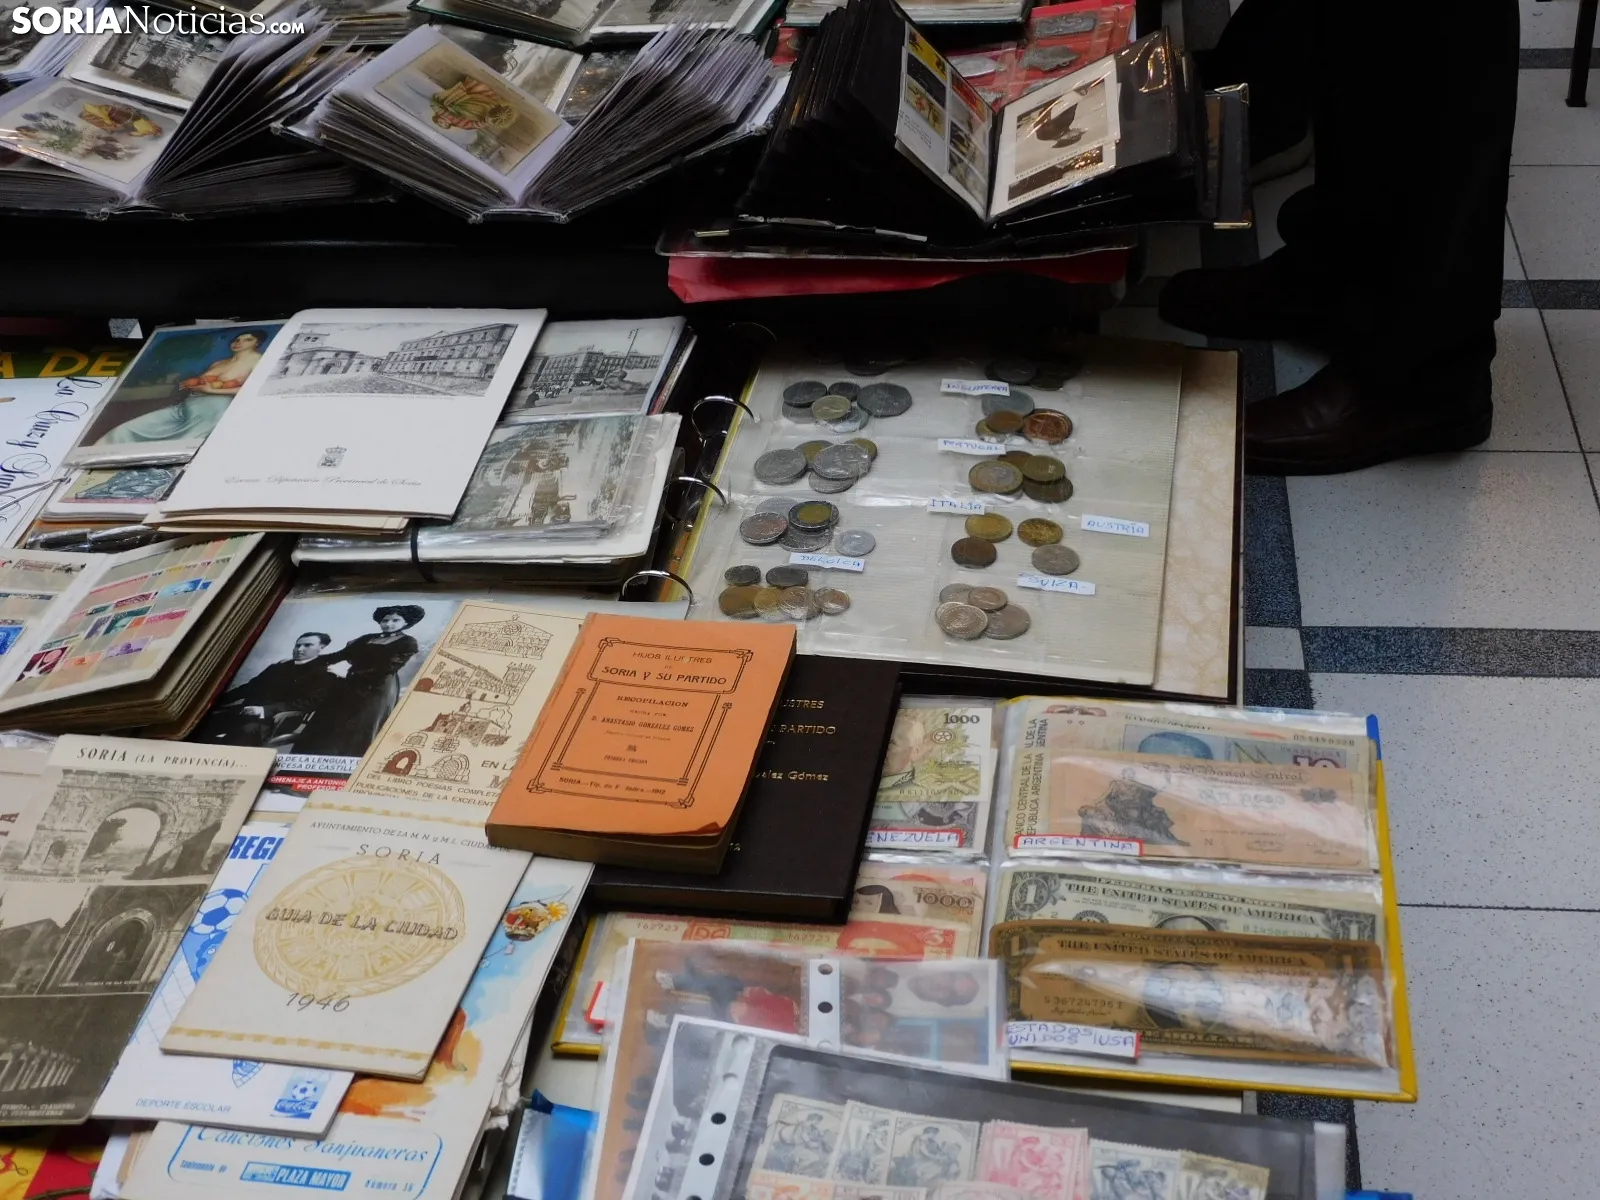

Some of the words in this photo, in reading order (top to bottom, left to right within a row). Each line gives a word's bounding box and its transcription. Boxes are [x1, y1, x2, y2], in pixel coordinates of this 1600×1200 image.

[602, 666, 637, 678] SORIA
[656, 672, 672, 681] SU
[676, 674, 727, 686] PARTIDO
[943, 713, 981, 725] 1000
[779, 724, 836, 735] PARTIDO
[77, 747, 128, 762] SORIA
[312, 757, 343, 765] LENGUA
[481, 760, 500, 769] EN
[366, 773, 382, 781] DEL
[387, 775, 412, 785] LIBRO
[415, 778, 453, 791] POESIAS
[422, 791, 434, 799] DE
[436, 793, 448, 801] LA
[1016, 780, 1031, 811] CENTRAL
[310, 821, 382, 835] AYUNTAMIENTO
[382, 829, 396, 837] DE
[396, 830, 409, 838] LA
[1023, 837, 1133, 851] ARGENTINA
[356, 843, 441, 865] SORIA
[916, 891, 973, 909] 1000
[1065, 882, 1097, 895] THE
[1101, 887, 1158, 903] UNITED
[1161, 893, 1218, 911] STATES
[1221, 904, 1243, 916] OF
[1246, 907, 1318, 925] AMERICA
[318, 911, 347, 927] DE
[350, 915, 377, 931] LA
[384, 920, 458, 940] CIUDAD
[1057, 939, 1088, 950] THE
[1093, 942, 1149, 955] UNITED
[1151, 948, 1208, 960] STATES
[1211, 952, 1232, 961] OF
[1235, 954, 1309, 968] AMERICA
[286, 991, 352, 1013] 1946
[1006, 1023, 1095, 1037] ESTADOS
[1008, 1033, 1079, 1046] UNIDOS
[136, 1098, 182, 1109] DEPORTE
[183, 1101, 232, 1113] ESCOLAR
[278, 1167, 309, 1187] PLAZA
[309, 1170, 346, 1190] MAYOR
